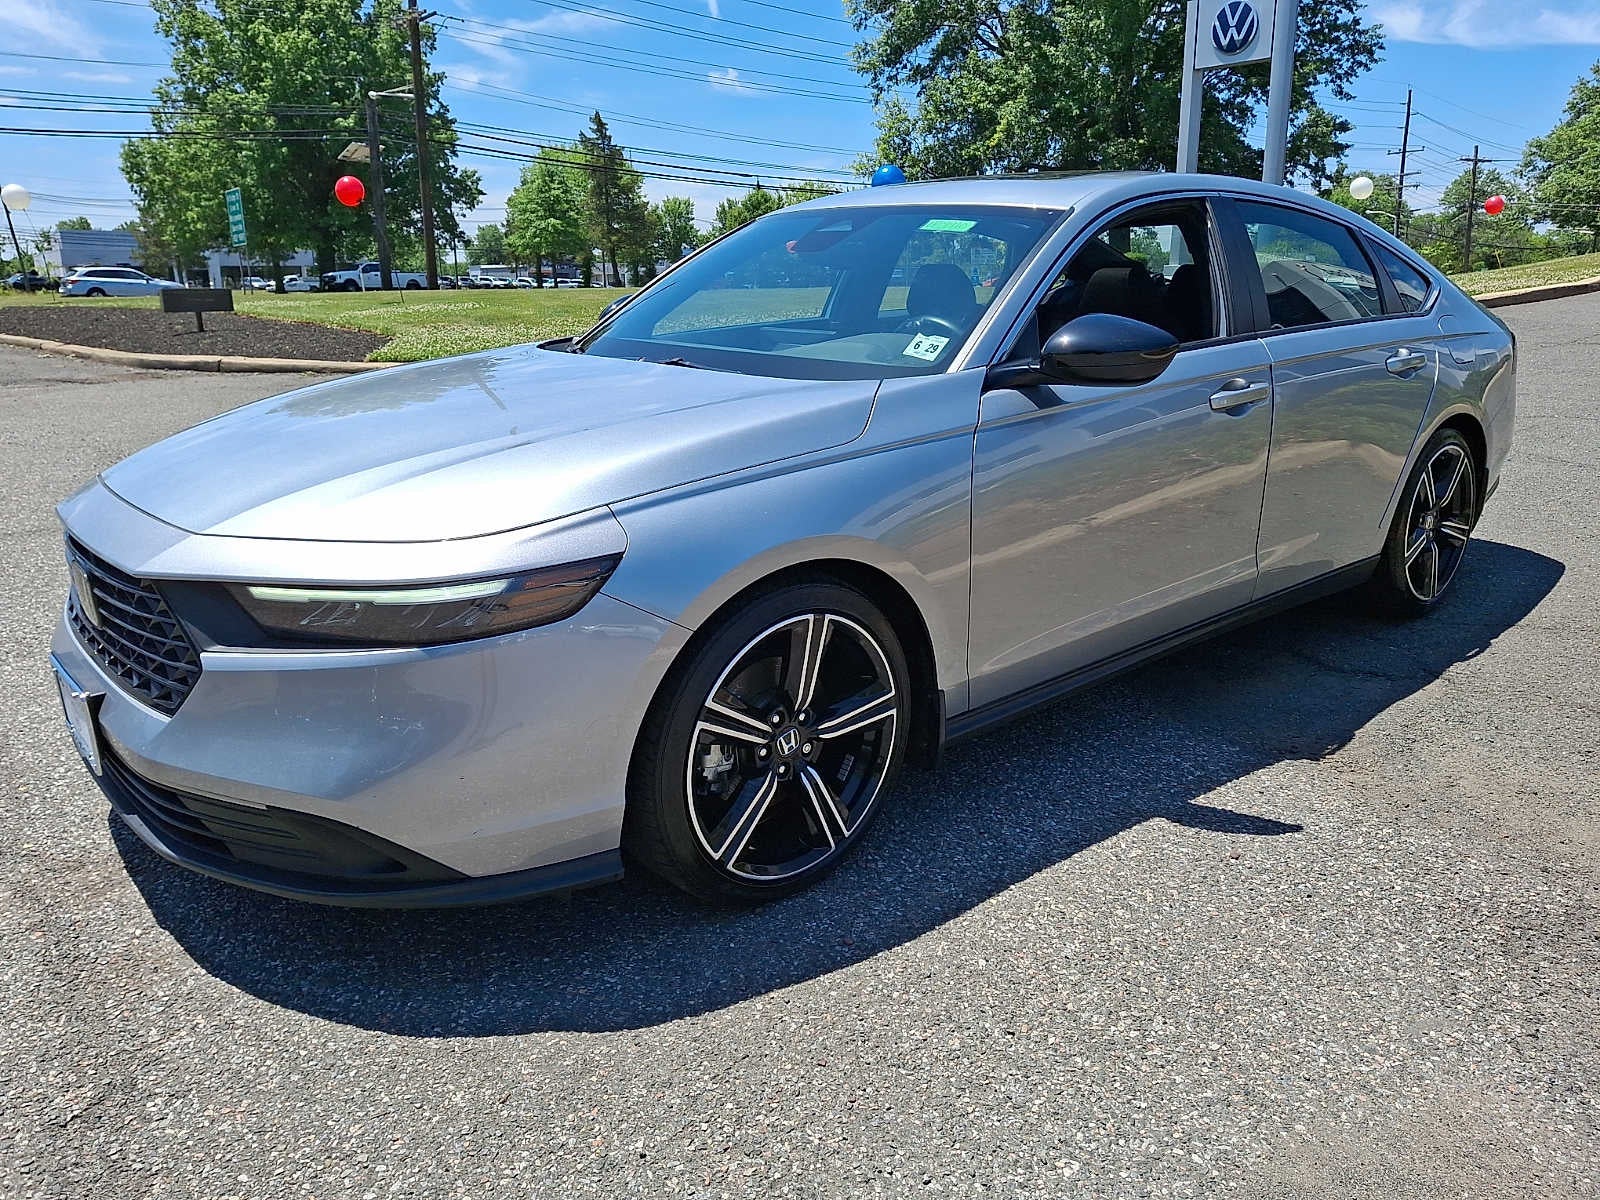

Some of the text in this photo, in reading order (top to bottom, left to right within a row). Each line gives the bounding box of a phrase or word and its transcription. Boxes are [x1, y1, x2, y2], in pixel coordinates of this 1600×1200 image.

[1211, 0, 1257, 53] VW
[913, 340, 923, 350] 6
[924, 343, 940, 354] 29
